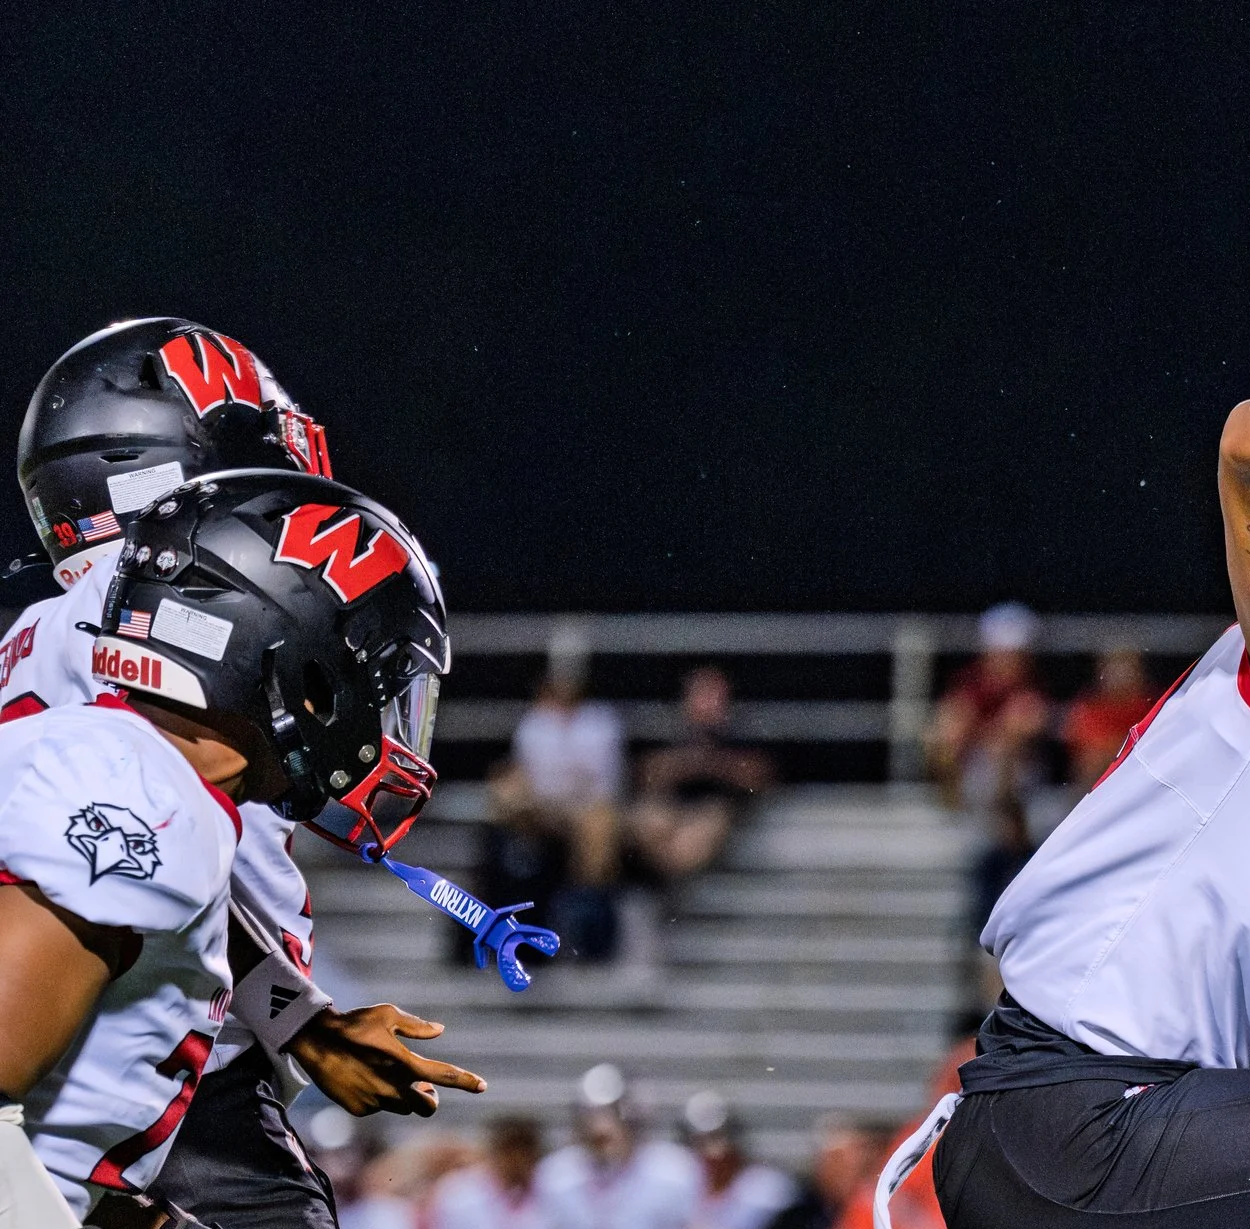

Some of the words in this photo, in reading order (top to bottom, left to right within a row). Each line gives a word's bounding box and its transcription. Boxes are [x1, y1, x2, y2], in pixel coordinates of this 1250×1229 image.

[159, 332, 262, 419] W
[128, 468, 156, 479] WARNING
[273, 503, 411, 604] W
[92, 645, 162, 689] iddell
[430, 879, 487, 928] NXTRND
